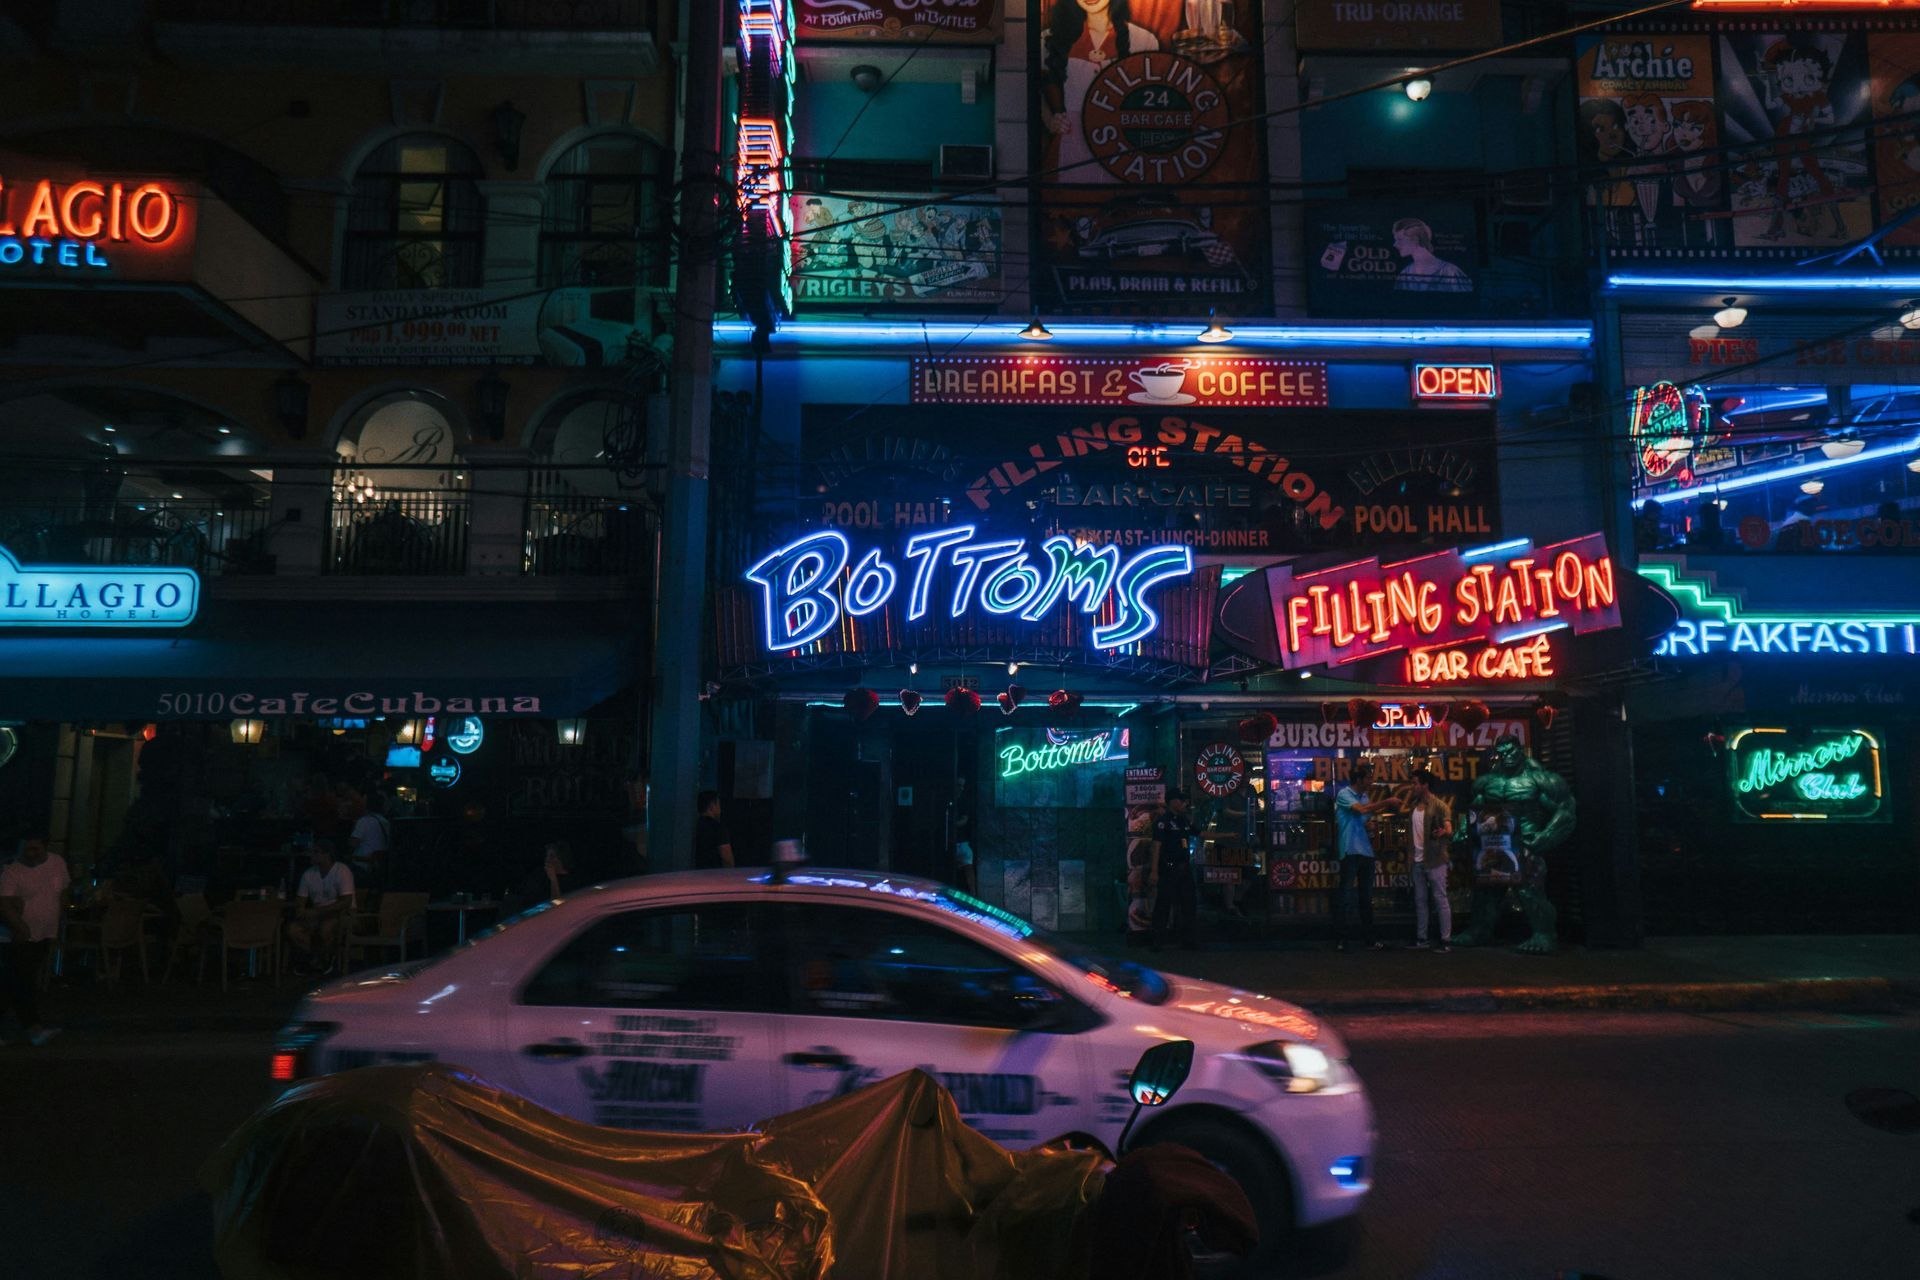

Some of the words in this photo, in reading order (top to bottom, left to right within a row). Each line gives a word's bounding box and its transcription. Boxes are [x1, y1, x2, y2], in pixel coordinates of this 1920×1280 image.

[804, 14, 817, 26] AT
[821, 9, 884, 27] FOUNTAINS
[914, 12, 926, 23] IN
[926, 9, 977, 29] BOTTLES
[1593, 43, 1692, 78] Archie
[1091, 57, 1219, 112] FILLING
[1143, 91, 1169, 107] 24
[1120, 113, 1149, 125] BAR
[1091, 125, 1223, 183] STATION
[1353, 245, 1391, 260] OLD
[1348, 257, 1397, 272] GOLD
[1069, 275, 1117, 292] PLAY,
[1119, 276, 1169, 292] DRAIN
[1173, 277, 1187, 292] &
[1190, 278, 1244, 294] REFILL
[345, 305, 449, 320] STANDARD
[451, 304, 508, 320] ROOM
[469, 326, 501, 343] NET
[1689, 338, 1760, 365] PIES
[924, 368, 1095, 395] BREAKFAST
[1101, 368, 1128, 397] &
[1197, 371, 1315, 397] COFFEE
[1418, 367, 1492, 395] OPEN
[964, 416, 1143, 512] FILLING
[1157, 416, 1345, 531] STATION
[822, 501, 888, 529] POOL
[1353, 505, 1418, 533] POOL
[1427, 504, 1492, 532] HALL
[1287, 570, 1443, 654] FILLING
[1456, 550, 1616, 626] STATION
[57, 609, 160, 619] HOTEL
[1408, 648, 1470, 684] BAR
[1269, 721, 1370, 748] BURGER
[1197, 744, 1242, 767] FILLING
[1125, 768, 1158, 777] ENTRANCE
[1197, 771, 1243, 795] STATION
[1206, 871, 1218, 880] NO
[1298, 860, 1341, 875] COLD
